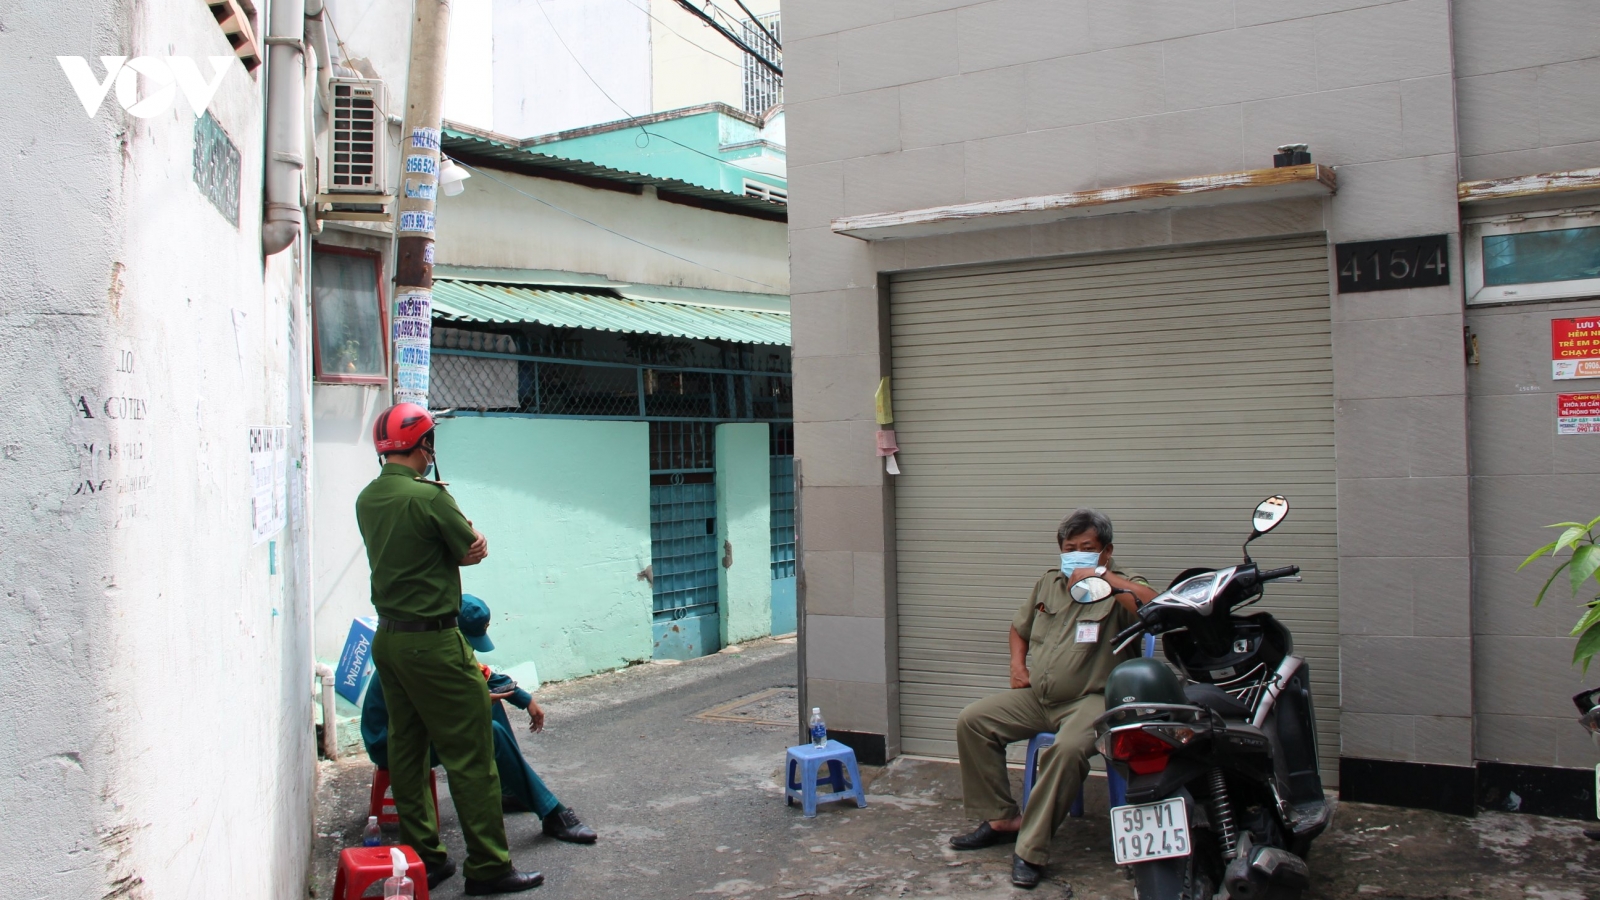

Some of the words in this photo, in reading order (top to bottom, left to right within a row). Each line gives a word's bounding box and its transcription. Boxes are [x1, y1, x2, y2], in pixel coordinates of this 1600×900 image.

[1340, 245, 1446, 282] 415/4
[1561, 349, 1588, 357] CHẠY
[249, 428, 262, 454] CHO
[343, 633, 371, 687] AQUAFINA
[1122, 804, 1173, 833] 59-V1
[1118, 828, 1186, 859] 192.45
